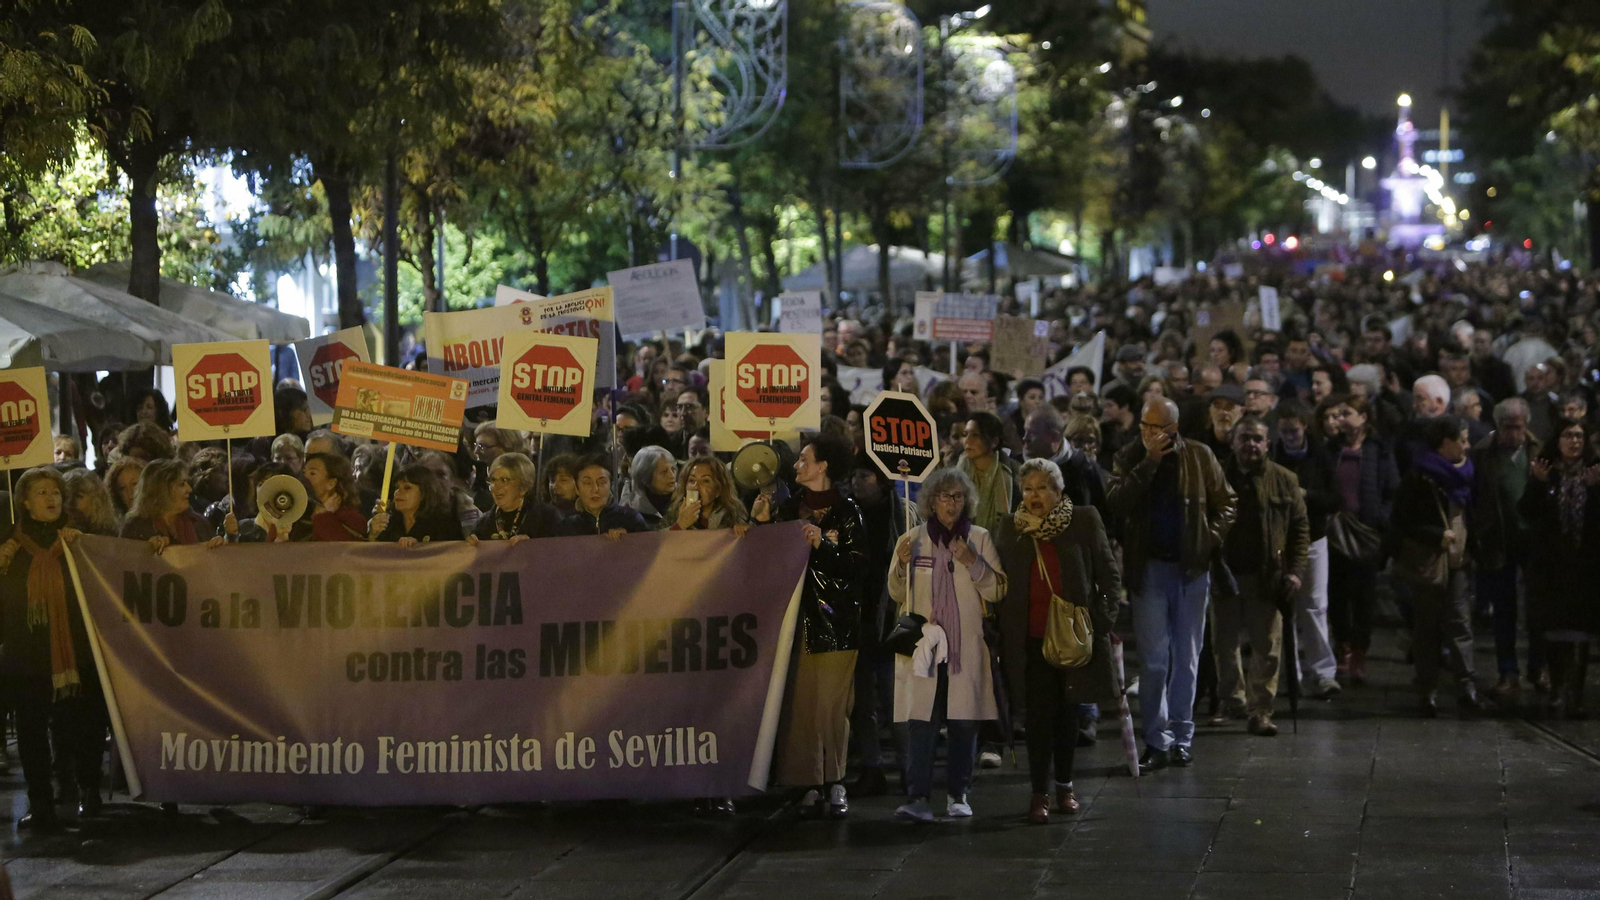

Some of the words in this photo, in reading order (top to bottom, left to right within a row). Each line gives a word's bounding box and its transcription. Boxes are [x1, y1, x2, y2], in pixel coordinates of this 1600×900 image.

[188, 370, 258, 399] STOP
[513, 362, 582, 390] STOP
[738, 363, 807, 389] STOP
[517, 392, 542, 402] GENITAL
[544, 395, 575, 405] FEMENINA
[341, 409, 350, 417] NO
[354, 411, 361, 419] la
[406, 419, 460, 436] MERCANTILIZACIÓN
[382, 424, 392, 432] del
[393, 427, 413, 438] cuerpo
[414, 428, 422, 437] de
[422, 430, 432, 439] las
[432, 432, 458, 444] mujeres
[871, 415, 930, 448] STOP
[872, 442, 900, 454] Justicia
[899, 444, 933, 458] Patriarcal
[122, 570, 188, 627] NO
[201, 599, 221, 628] a
[229, 592, 261, 629] la
[273, 571, 524, 629] VIOLENCIA
[346, 647, 462, 683] contra
[475, 644, 526, 680] las
[539, 613, 758, 677] MUJERES
[160, 731, 365, 775] Movimiento
[376, 732, 542, 774] Feminista
[555, 731, 596, 771] de
[608, 726, 719, 769] Sevilla
